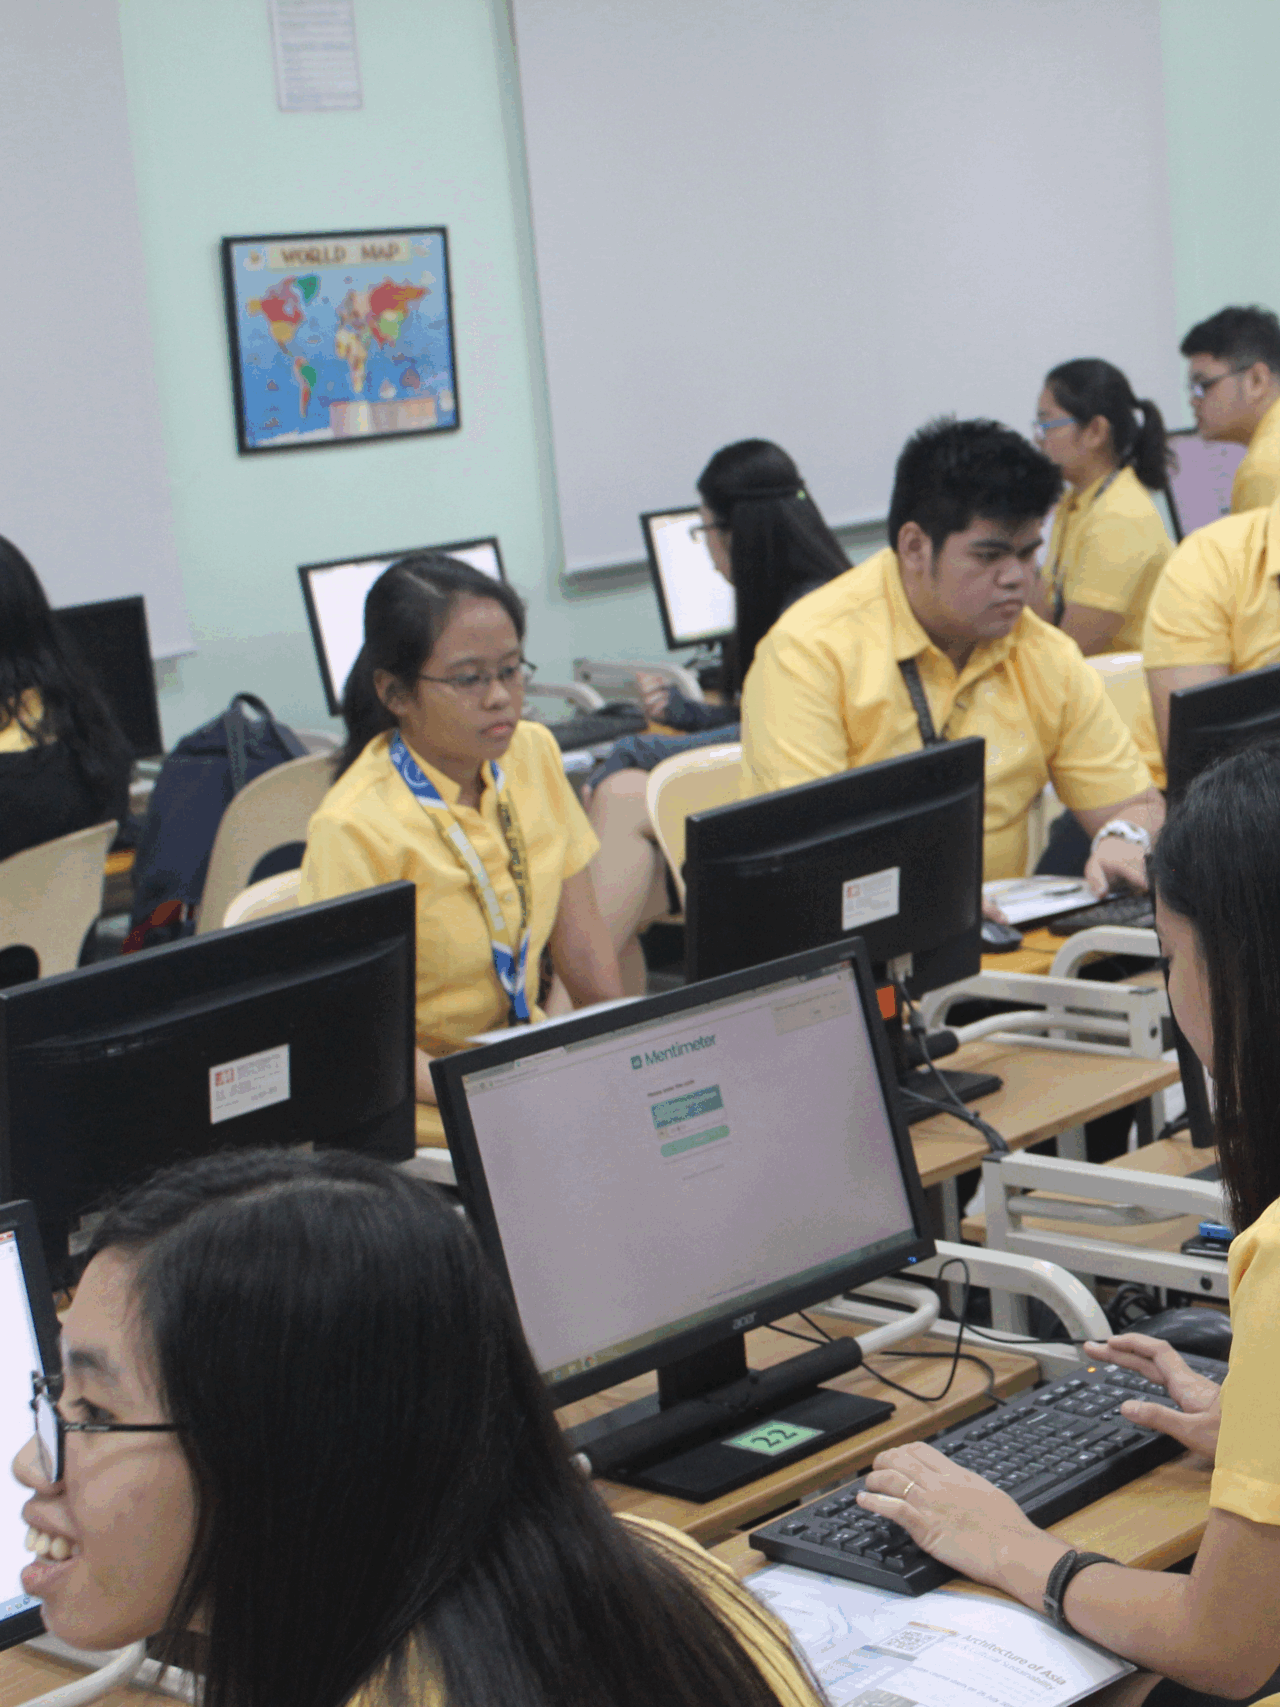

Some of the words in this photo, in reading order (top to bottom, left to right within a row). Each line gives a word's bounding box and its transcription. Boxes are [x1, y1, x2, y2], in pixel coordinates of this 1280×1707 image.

[281, 245, 347, 264] WORLD
[361, 242, 400, 260] MAP
[644, 1034, 717, 1066] Mentimeter
[733, 1311, 757, 1330] acer
[751, 1429, 798, 1449] 22
[961, 1634, 1028, 1666] Architecture
[1027, 1662, 1044, 1671] of
[1039, 1670, 1067, 1686] Asia
